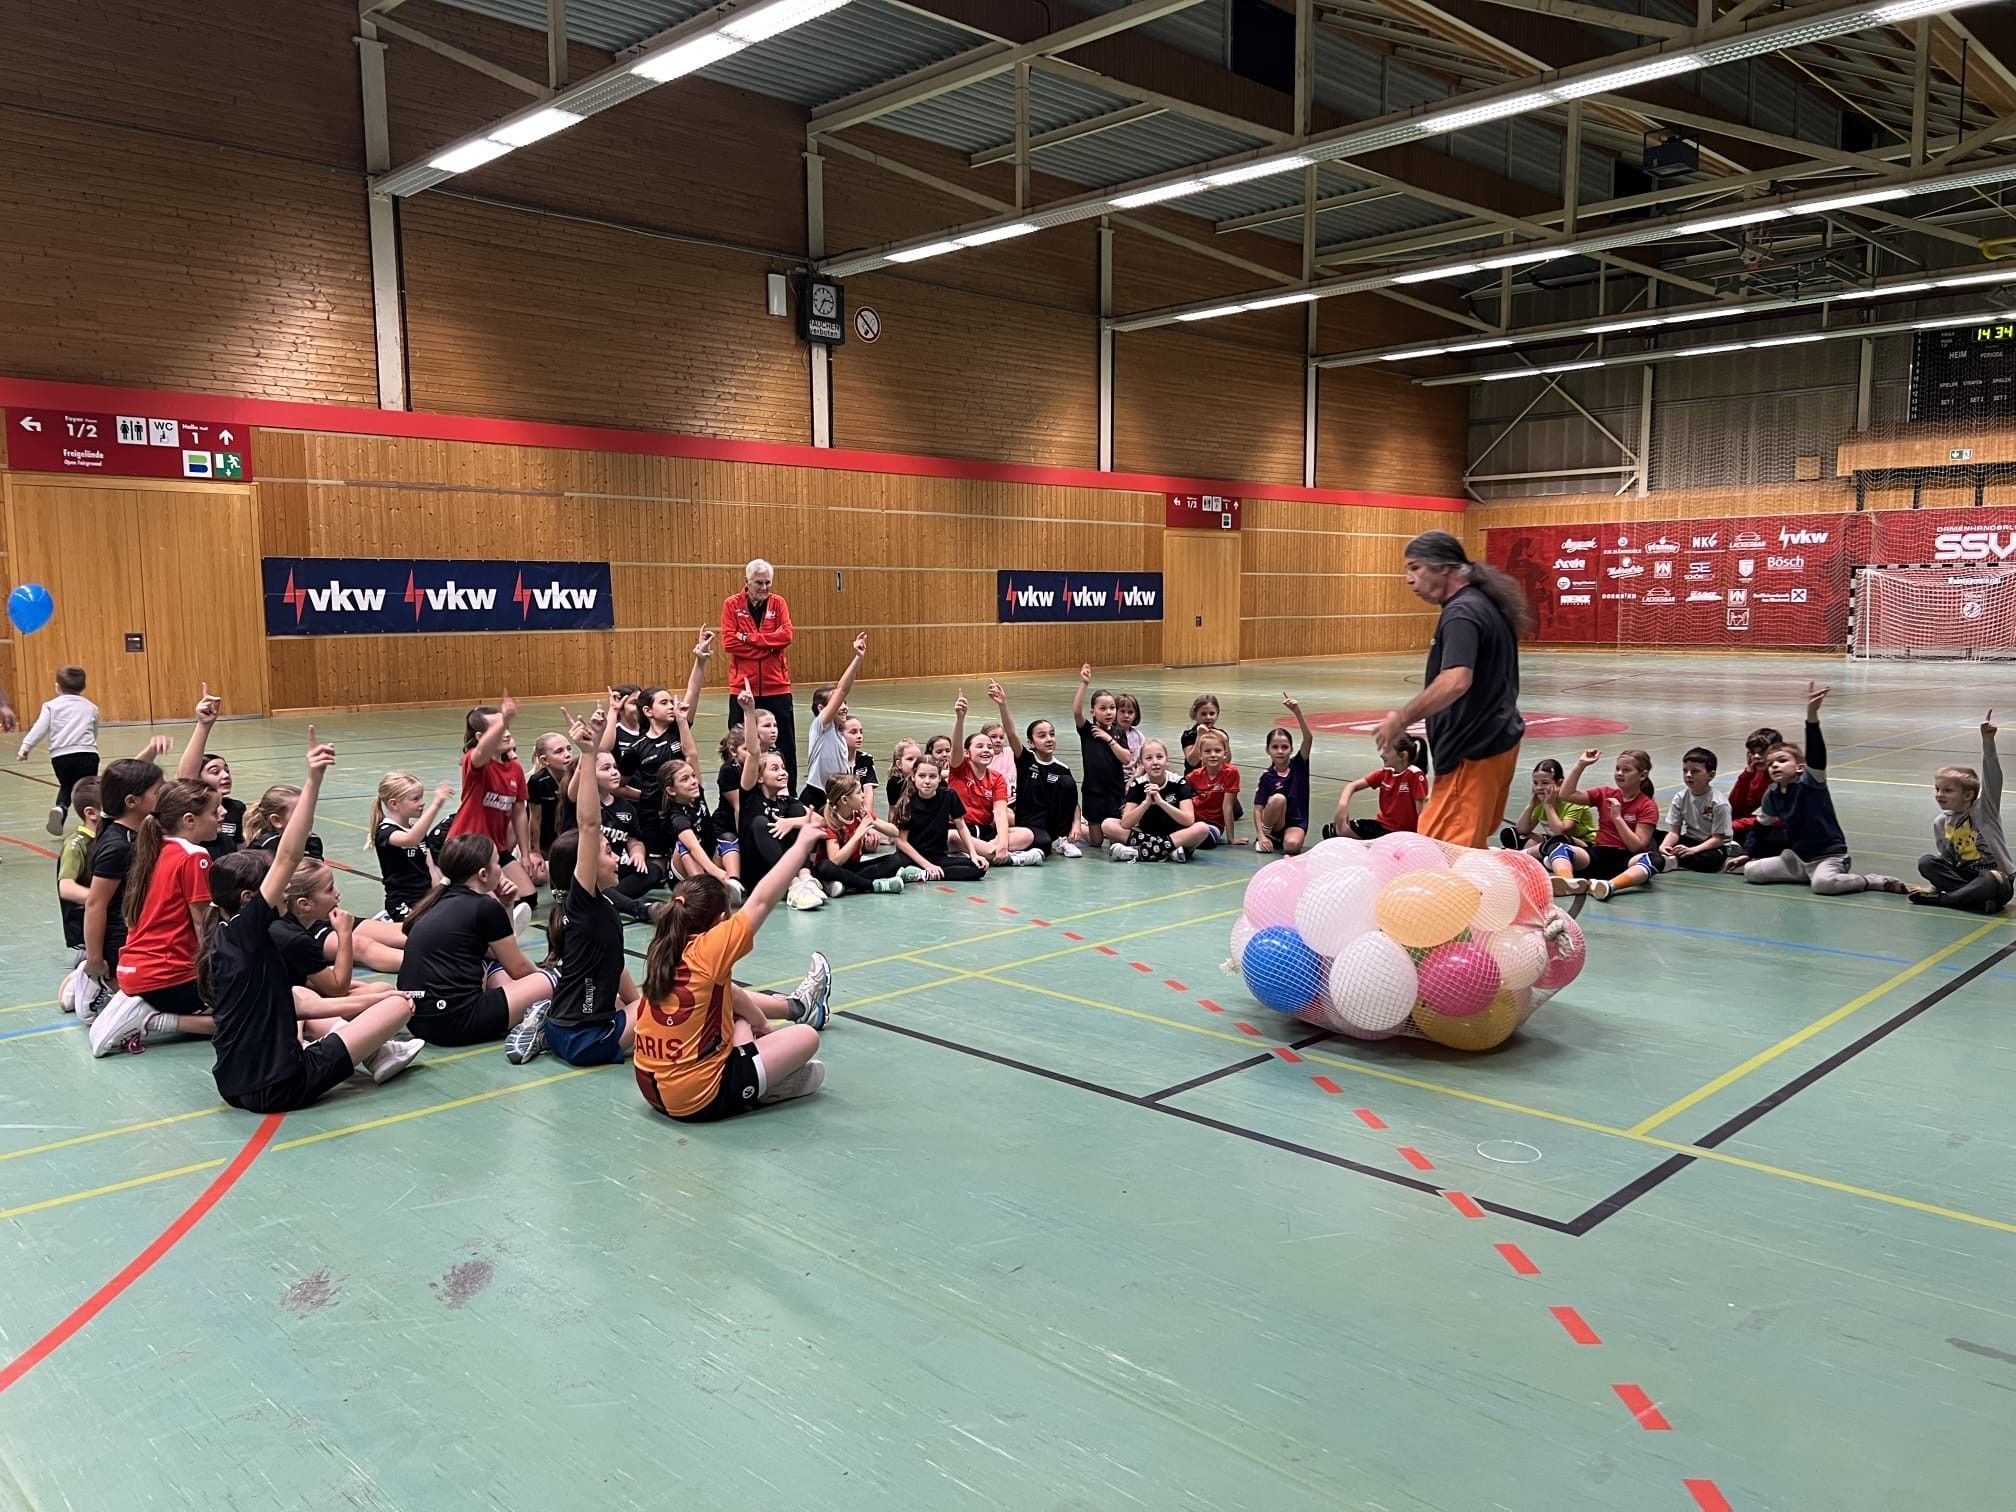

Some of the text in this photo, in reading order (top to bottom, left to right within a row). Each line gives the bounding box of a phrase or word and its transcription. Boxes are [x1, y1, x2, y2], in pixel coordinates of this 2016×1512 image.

[1949, 350, 1967, 359] HEIM
[67, 424, 98, 438] 1/2
[154, 421, 173, 431] WC
[192, 432, 199, 444] 1
[63, 449, 104, 459] Freigelände
[1692, 533, 1718, 548] NKG
[1790, 530, 1829, 544] vkw
[1934, 532, 2016, 560] SSV
[1767, 555, 1804, 567] Bösch
[307, 581, 597, 611] vkw vkw vkw
[1017, 585, 1156, 606] vkw vkw vkw
[635, 1033, 683, 1065] ARIŞ
